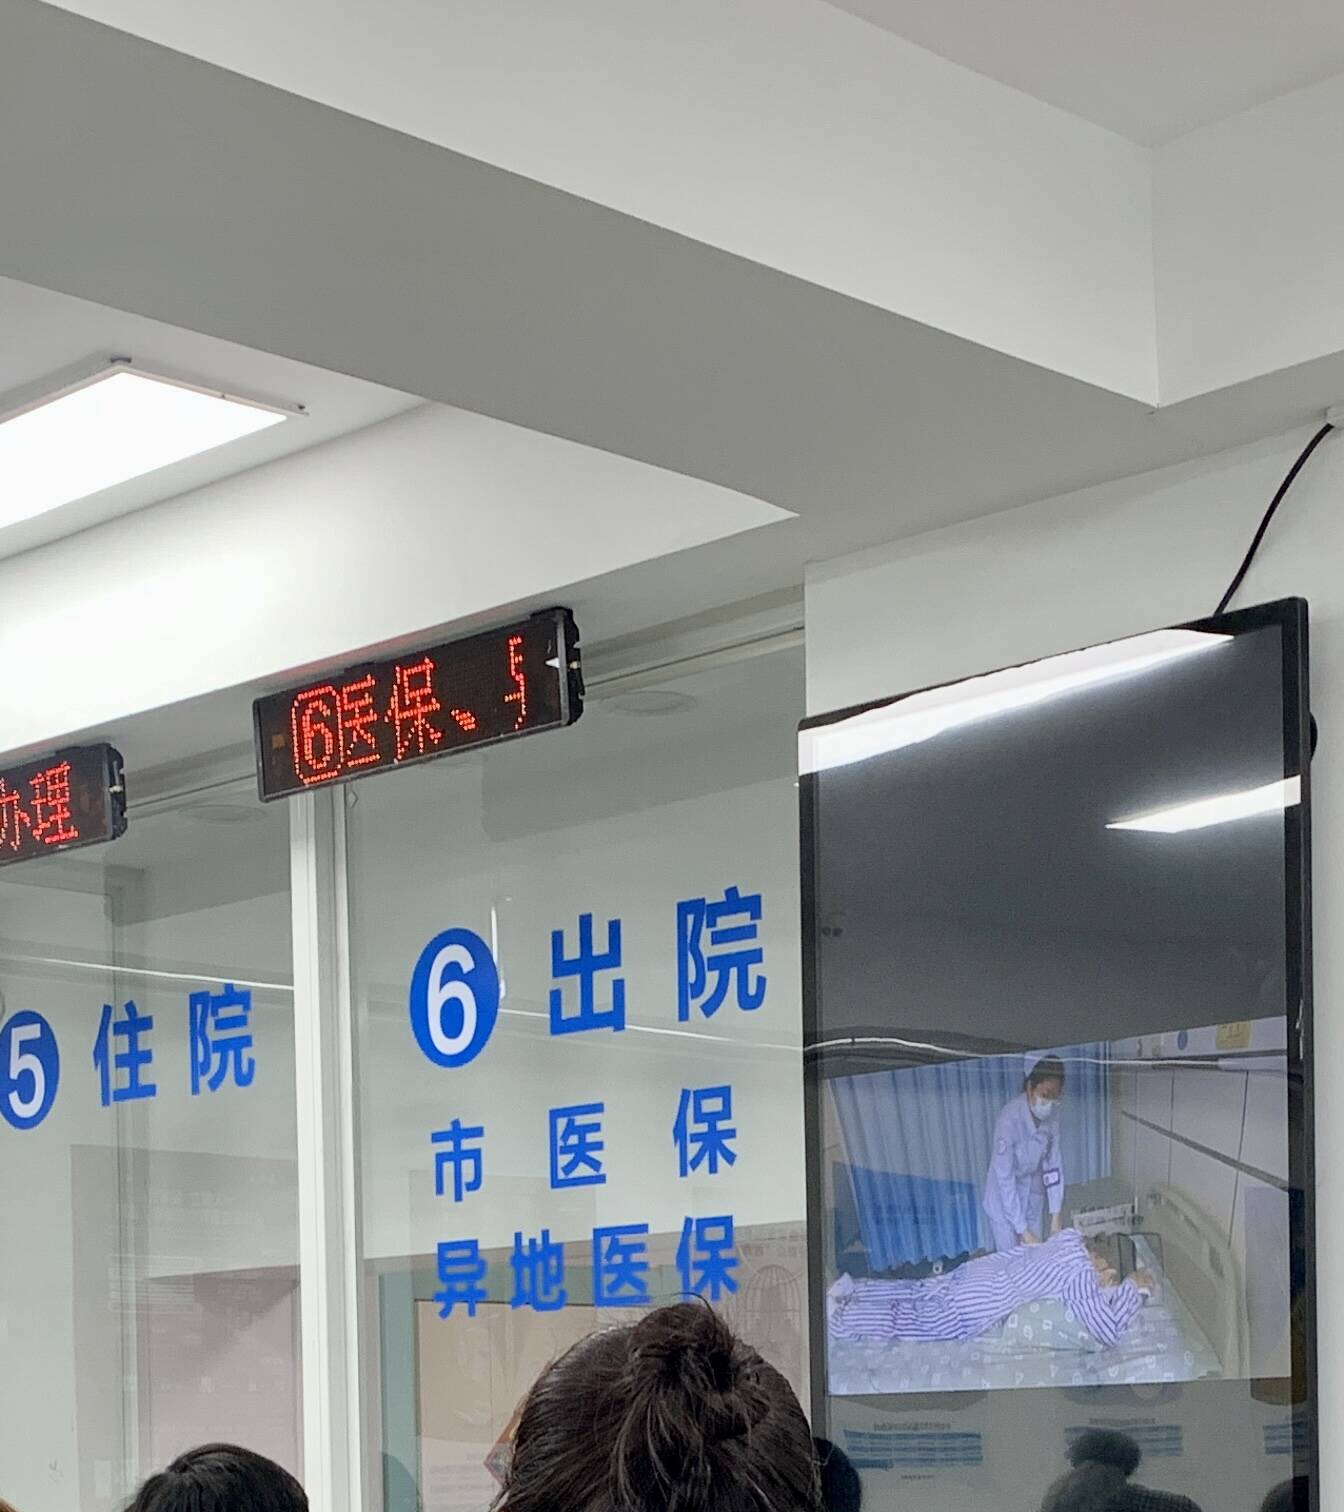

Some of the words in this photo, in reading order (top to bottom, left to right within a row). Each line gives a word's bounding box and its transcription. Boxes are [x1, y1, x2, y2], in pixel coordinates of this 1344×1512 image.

[549, 886, 767, 1037] 出院
[92, 983, 256, 1108] 住院
[431, 1084, 738, 1203] 市医保
[432, 1214, 741, 1320] 异地医保
